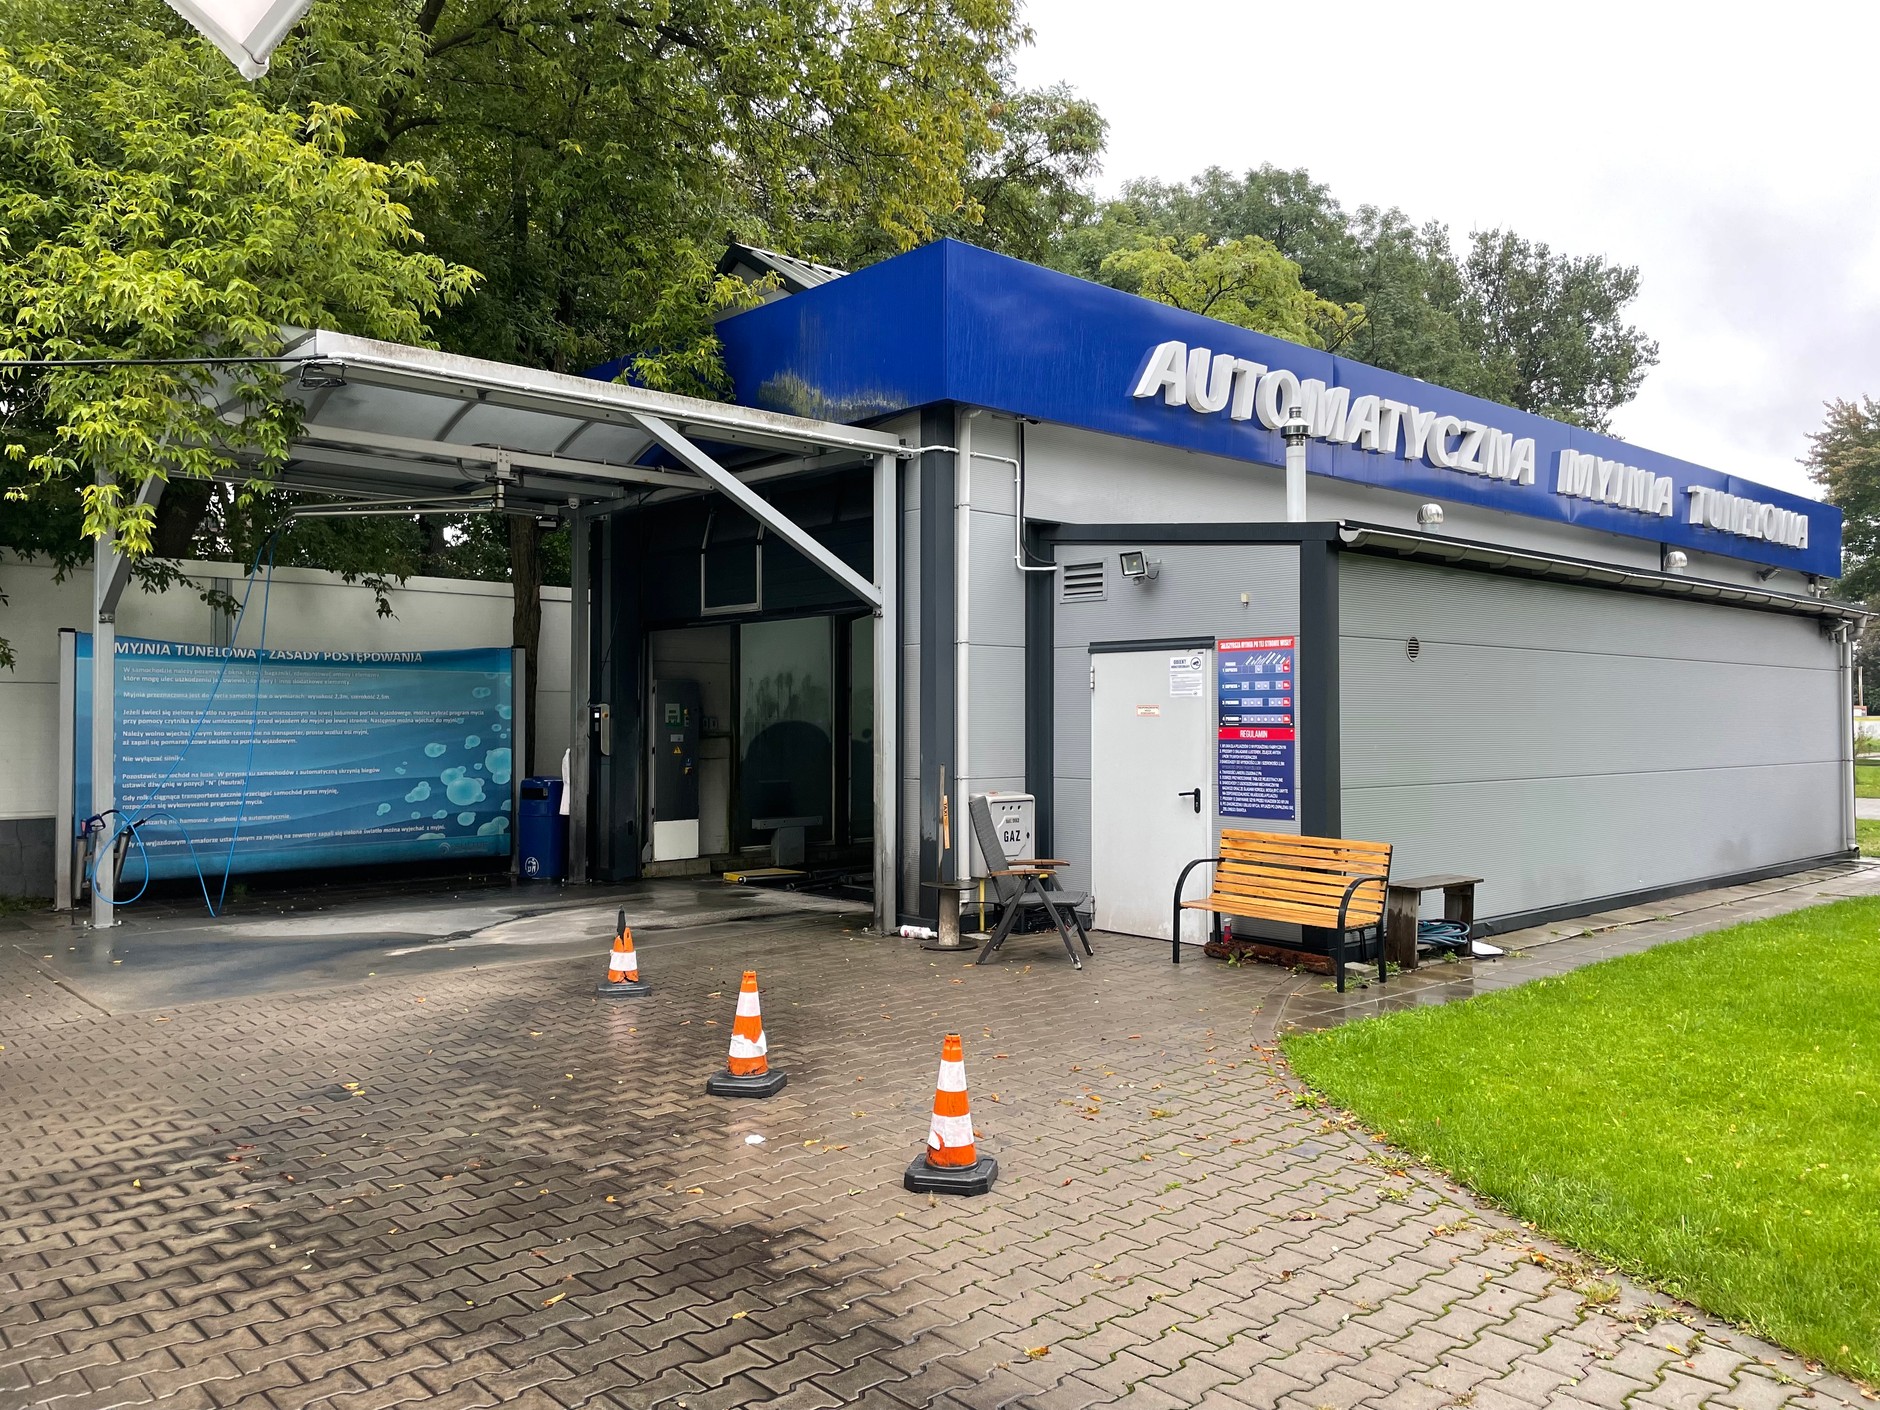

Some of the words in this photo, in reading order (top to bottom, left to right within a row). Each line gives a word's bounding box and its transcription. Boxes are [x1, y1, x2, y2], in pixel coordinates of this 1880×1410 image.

[1132, 340, 1536, 486] AUTOMATYCZNA
[1557, 448, 1673, 517] MYJNIA
[1687, 484, 1809, 549] TUNELOWA
[114, 642, 170, 656] MYJNIA
[175, 644, 256, 659] TUNELOWA
[269, 650, 324, 660] ZASADY
[324, 652, 422, 664] POSTĘPOWANIA
[1240, 730, 1268, 738] REGULAMIN
[1004, 830, 1020, 842] GAZ
